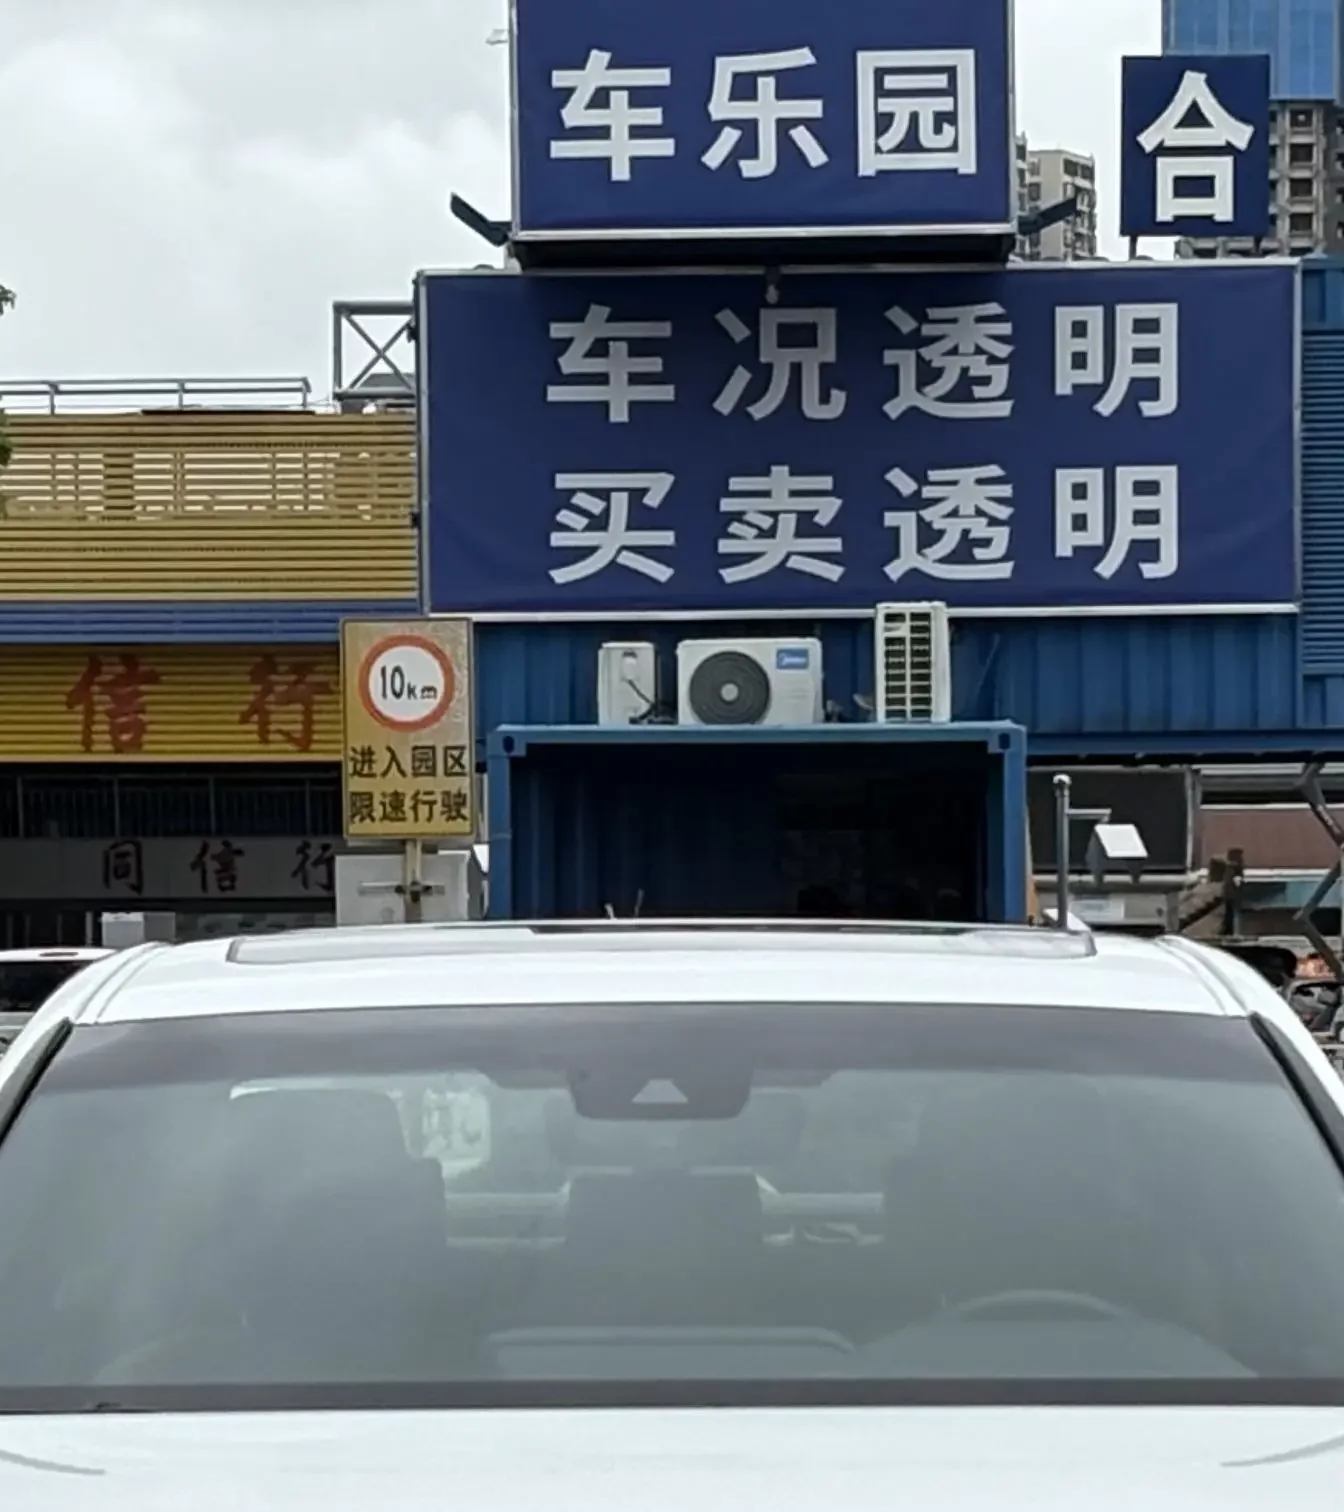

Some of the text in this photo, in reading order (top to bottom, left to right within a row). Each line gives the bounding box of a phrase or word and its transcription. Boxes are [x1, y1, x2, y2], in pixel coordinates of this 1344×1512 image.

[549, 47, 977, 182] 车乐园
[1136, 69, 1254, 224] 合
[546, 302, 1180, 423] 车况透明
[548, 464, 1180, 584] 买卖透明
[380, 665, 438, 700] 10km
[350, 745, 467, 778] 进入园区
[350, 790, 467, 823] 限速行驶
[104, 842, 334, 894] 同信行
